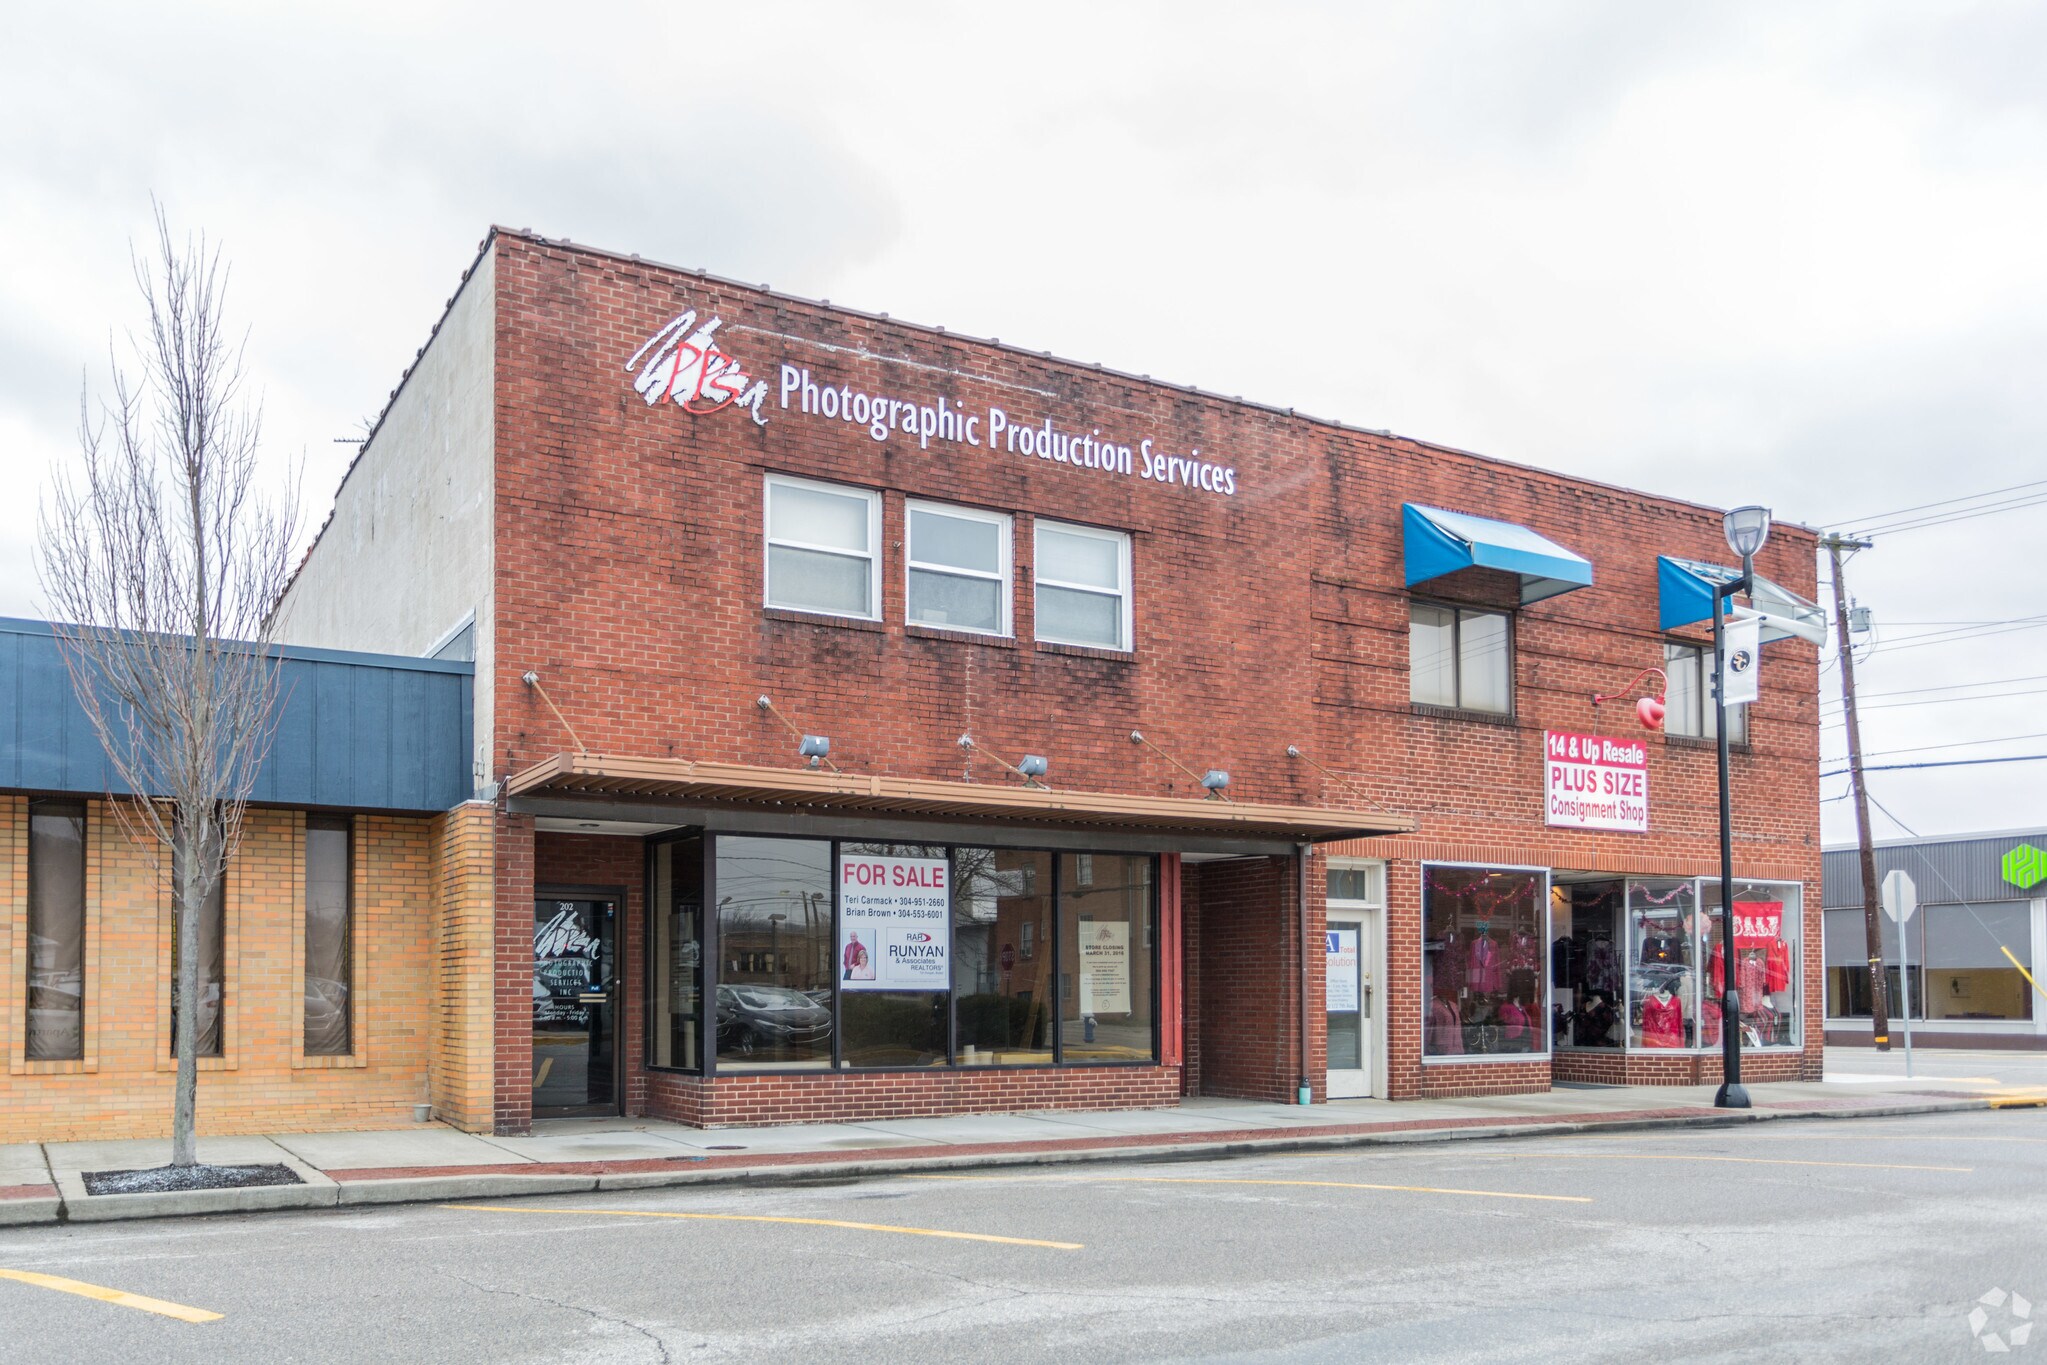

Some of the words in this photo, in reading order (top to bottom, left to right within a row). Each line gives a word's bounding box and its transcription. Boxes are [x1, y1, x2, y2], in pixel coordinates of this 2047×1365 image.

[781, 364, 979, 449] Photographic
[989, 407, 1132, 480] Production
[1139, 438, 1235, 501] Services
[1549, 734, 1565, 757] 14
[1568, 736, 1579, 759] &
[1582, 738, 1600, 764] Up
[1602, 740, 1644, 765] Resale
[1551, 766, 1597, 793] PLUS
[1603, 770, 1643, 797] SIZE
[1550, 793, 1617, 822] Consignment
[1619, 800, 1644, 827] Shop
[844, 863, 886, 886] FOR
[892, 865, 945, 888] SALE
[559, 902, 574, 911] 202
[844, 895, 859, 904] Teri
[861, 896, 893, 906] Carmack
[899, 897, 945, 907] 304-951-2660
[846, 907, 866, 917] Brian
[868, 908, 891, 917] Brown
[898, 909, 943, 919] 304-553-6001
[1732, 915, 1779, 937] SALE
[906, 932, 923, 941] RAR
[889, 945, 944, 957] RUNYAN
[1340, 946, 1355, 954] Total
[559, 988, 573, 996] INC
